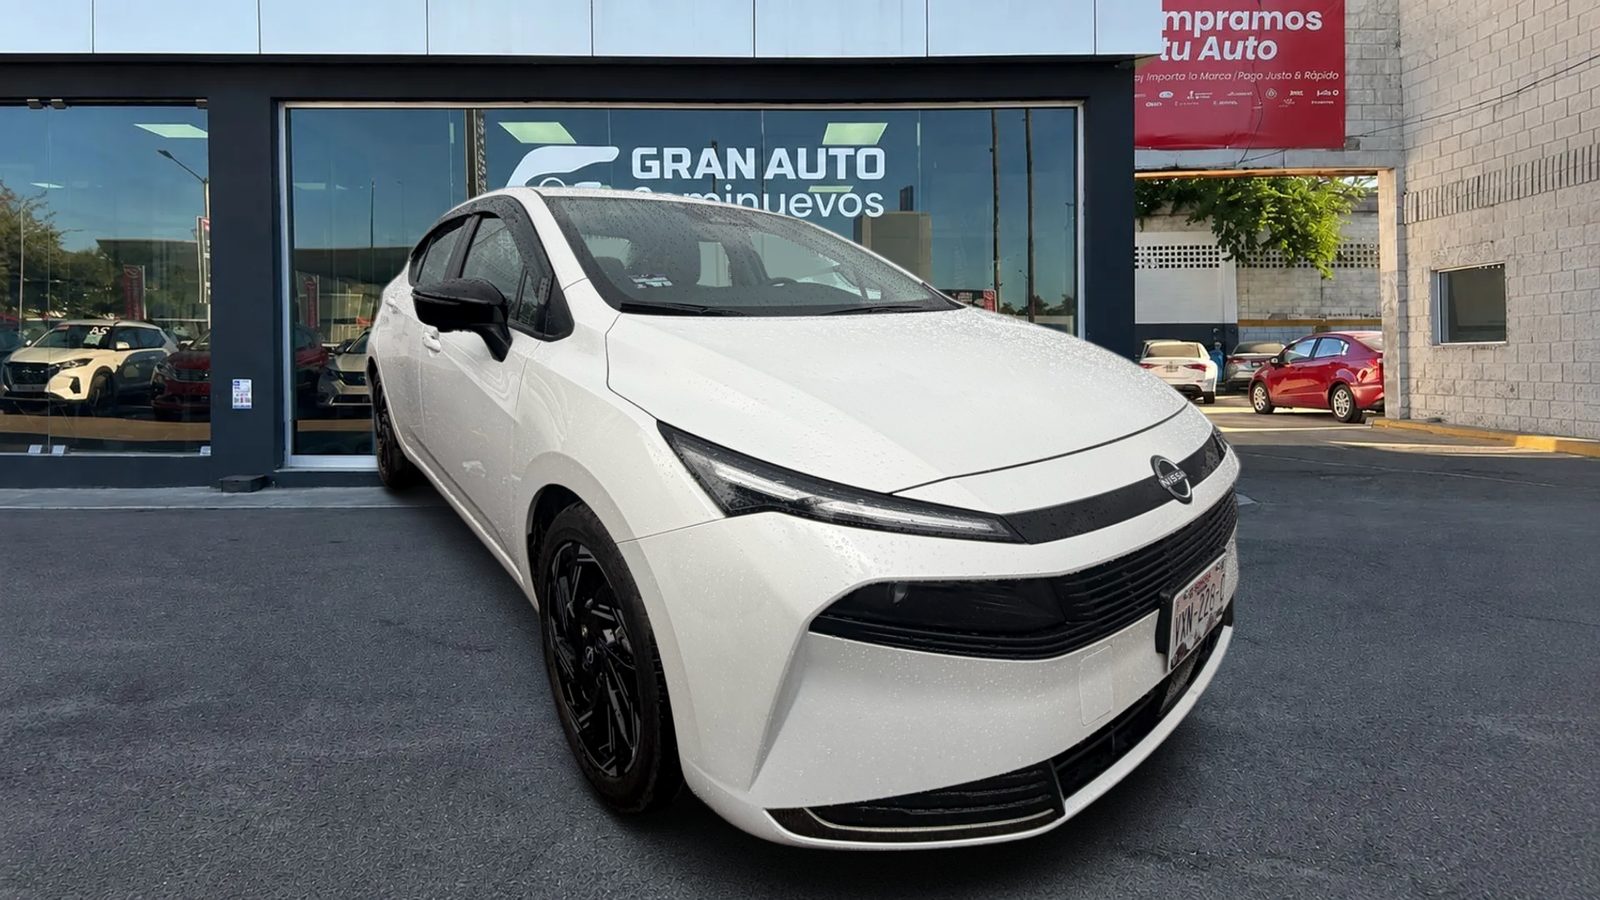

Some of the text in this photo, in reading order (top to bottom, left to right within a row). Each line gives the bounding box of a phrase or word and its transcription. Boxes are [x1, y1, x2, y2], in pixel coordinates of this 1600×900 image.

[1162, 10, 1323, 37] mpramos
[1160, 36, 1278, 61] tu Auto
[1147, 71, 1186, 82] Importa
[1200, 71, 1233, 81] Marca
[1266, 71, 1293, 81] Justo
[1294, 70, 1302, 80] &
[632, 147, 886, 180] GRAN AUTO
[633, 184, 884, 218] inuevos
[1160, 470, 1187, 486] NISSA
